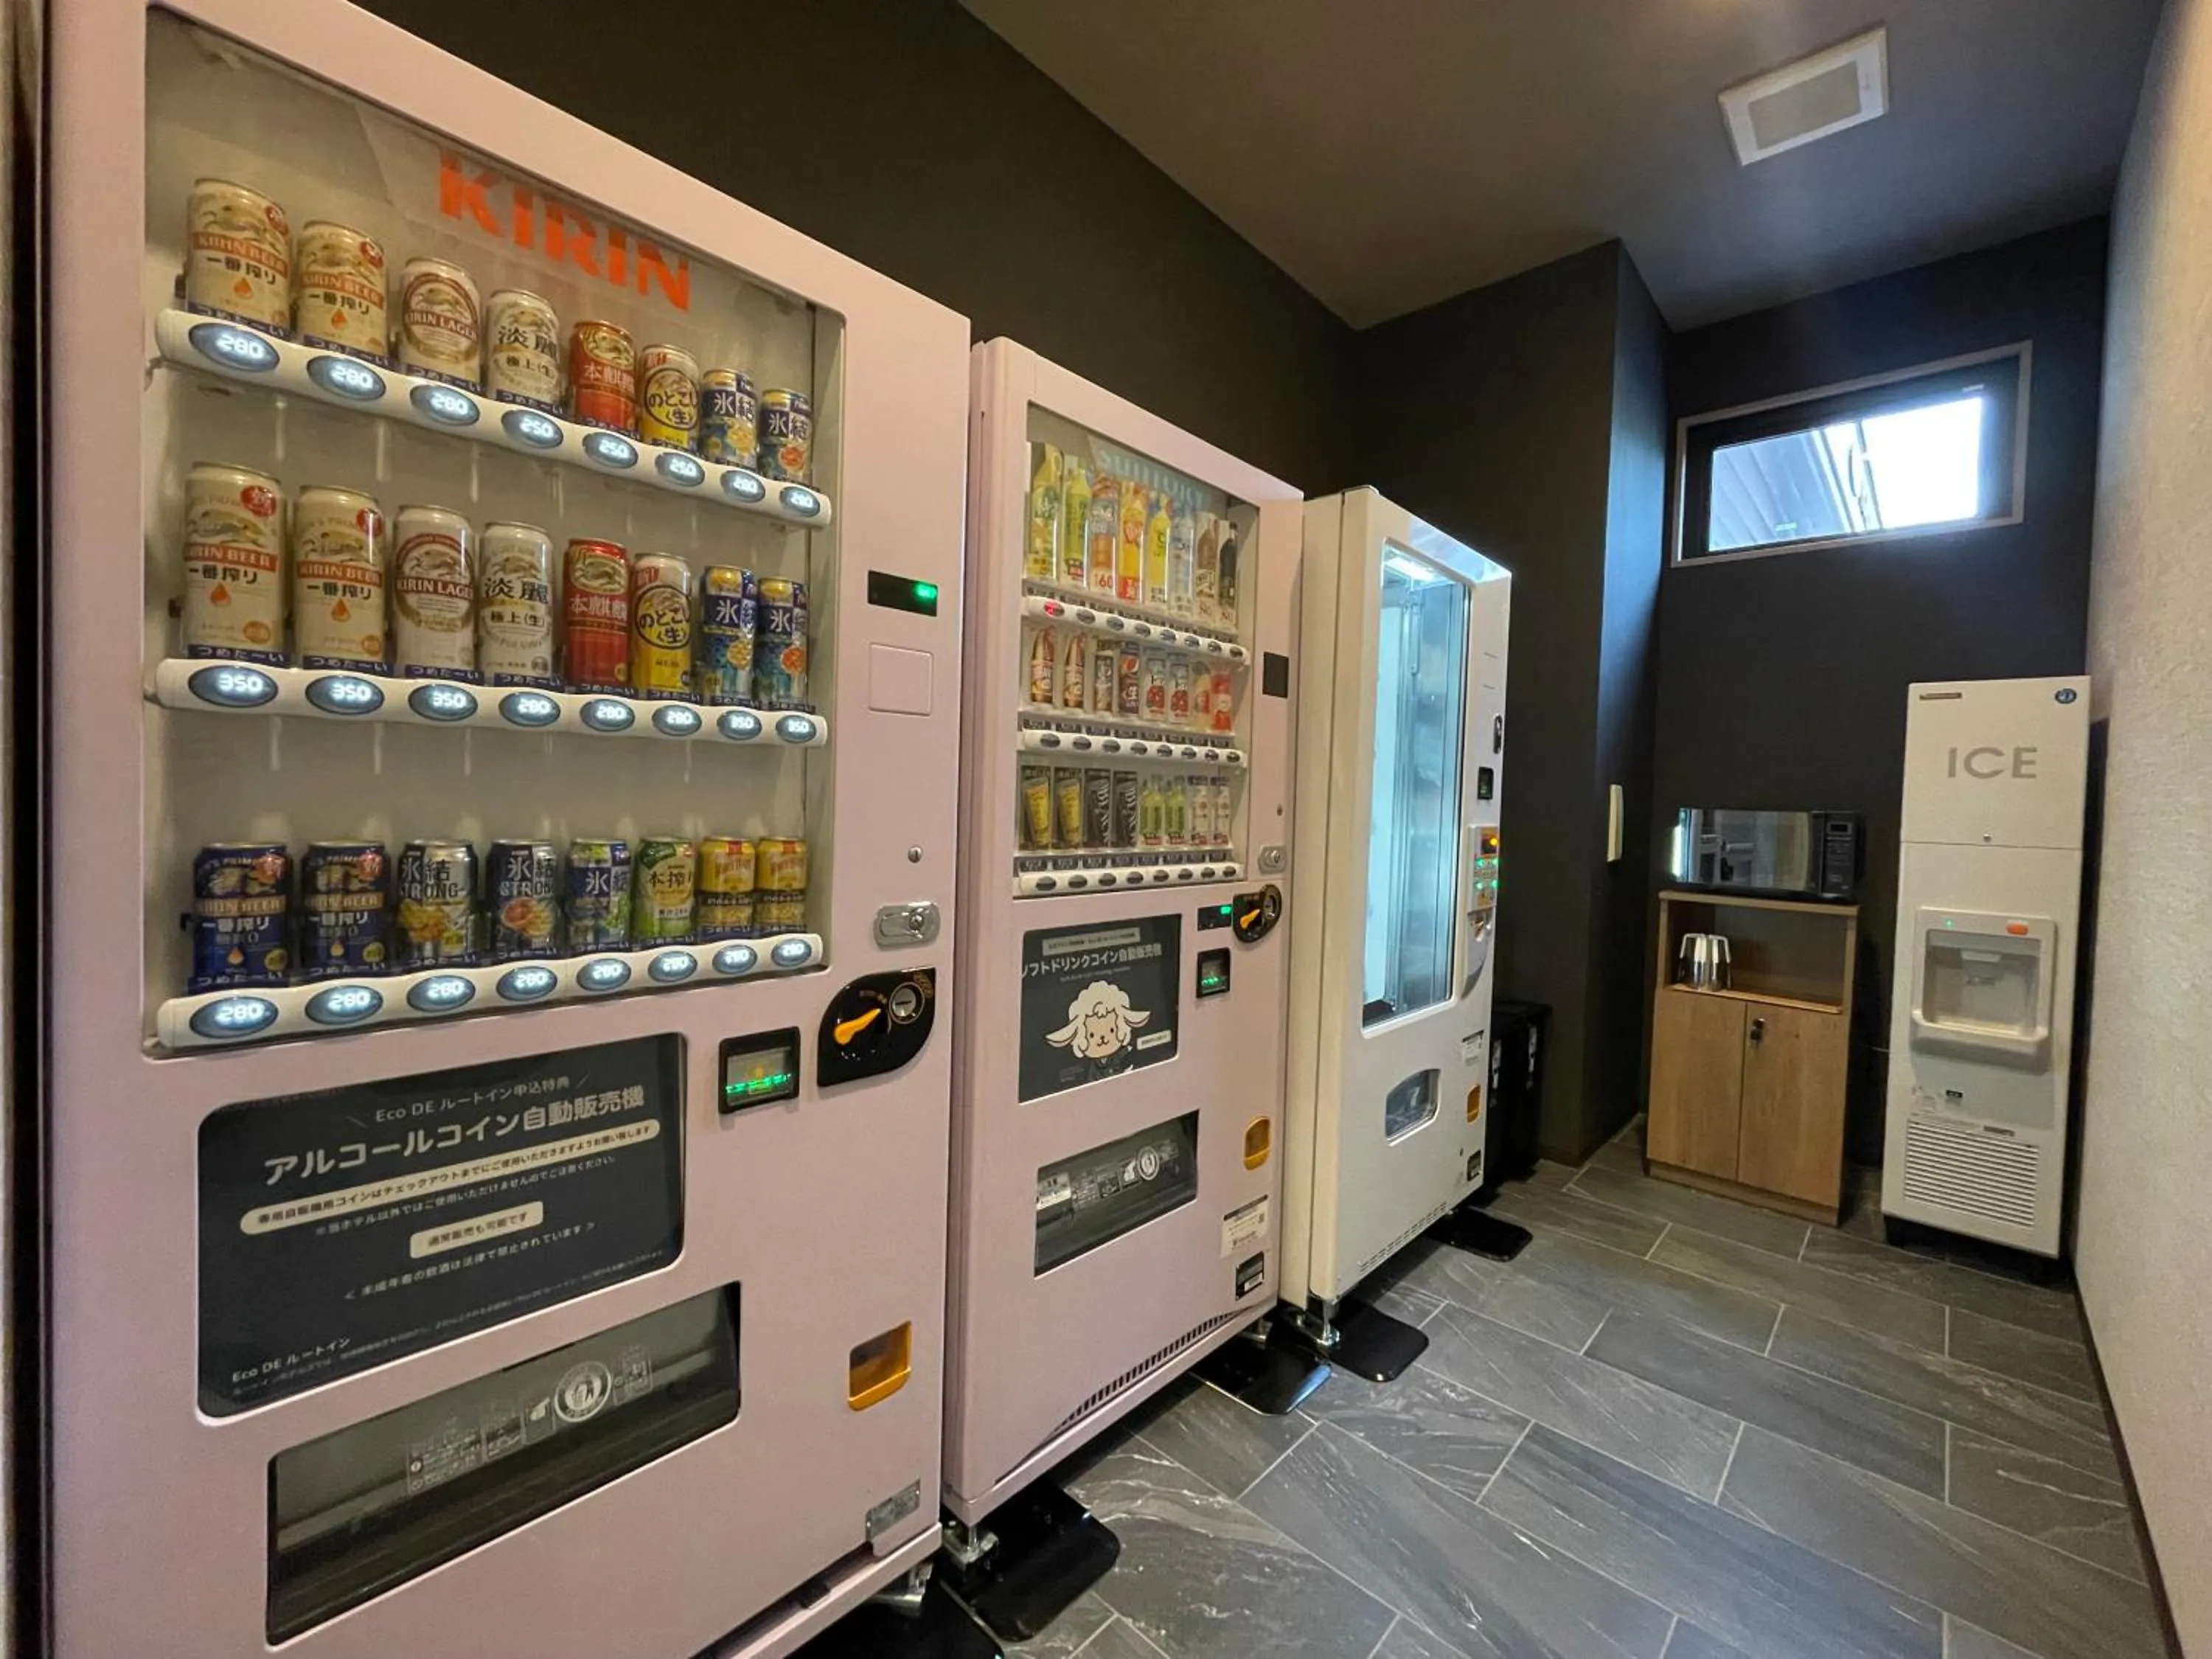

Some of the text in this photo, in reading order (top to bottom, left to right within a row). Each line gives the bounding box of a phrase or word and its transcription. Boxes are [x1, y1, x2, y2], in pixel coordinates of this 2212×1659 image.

[439, 153, 691, 310] KIRIN
[216, 332, 265, 359] 280
[331, 363, 373, 389] 280
[431, 392, 468, 414] 280
[520, 416, 554, 437] 250
[599, 438, 629, 458] 250
[189, 565, 258, 584] 一番搾り
[307, 582, 372, 600] 一番搾り
[219, 672, 263, 693] 350
[333, 682, 372, 701] 350
[433, 691, 467, 708] 350
[518, 698, 551, 714] 280
[1947, 746, 2037, 779] ICE
[428, 979, 465, 998] 280
[515, 971, 549, 988] 280
[328, 990, 370, 1009] 280
[216, 1002, 265, 1023] 280
[376, 1076, 571, 1122] Eco DE ルートイン申込特典
[264, 1084, 645, 1186] アルコールコイン自動販売機
[232, 1368, 259, 1384] Eco
[262, 1357, 283, 1374] DE
[286, 1337, 351, 1367] ルートイン
